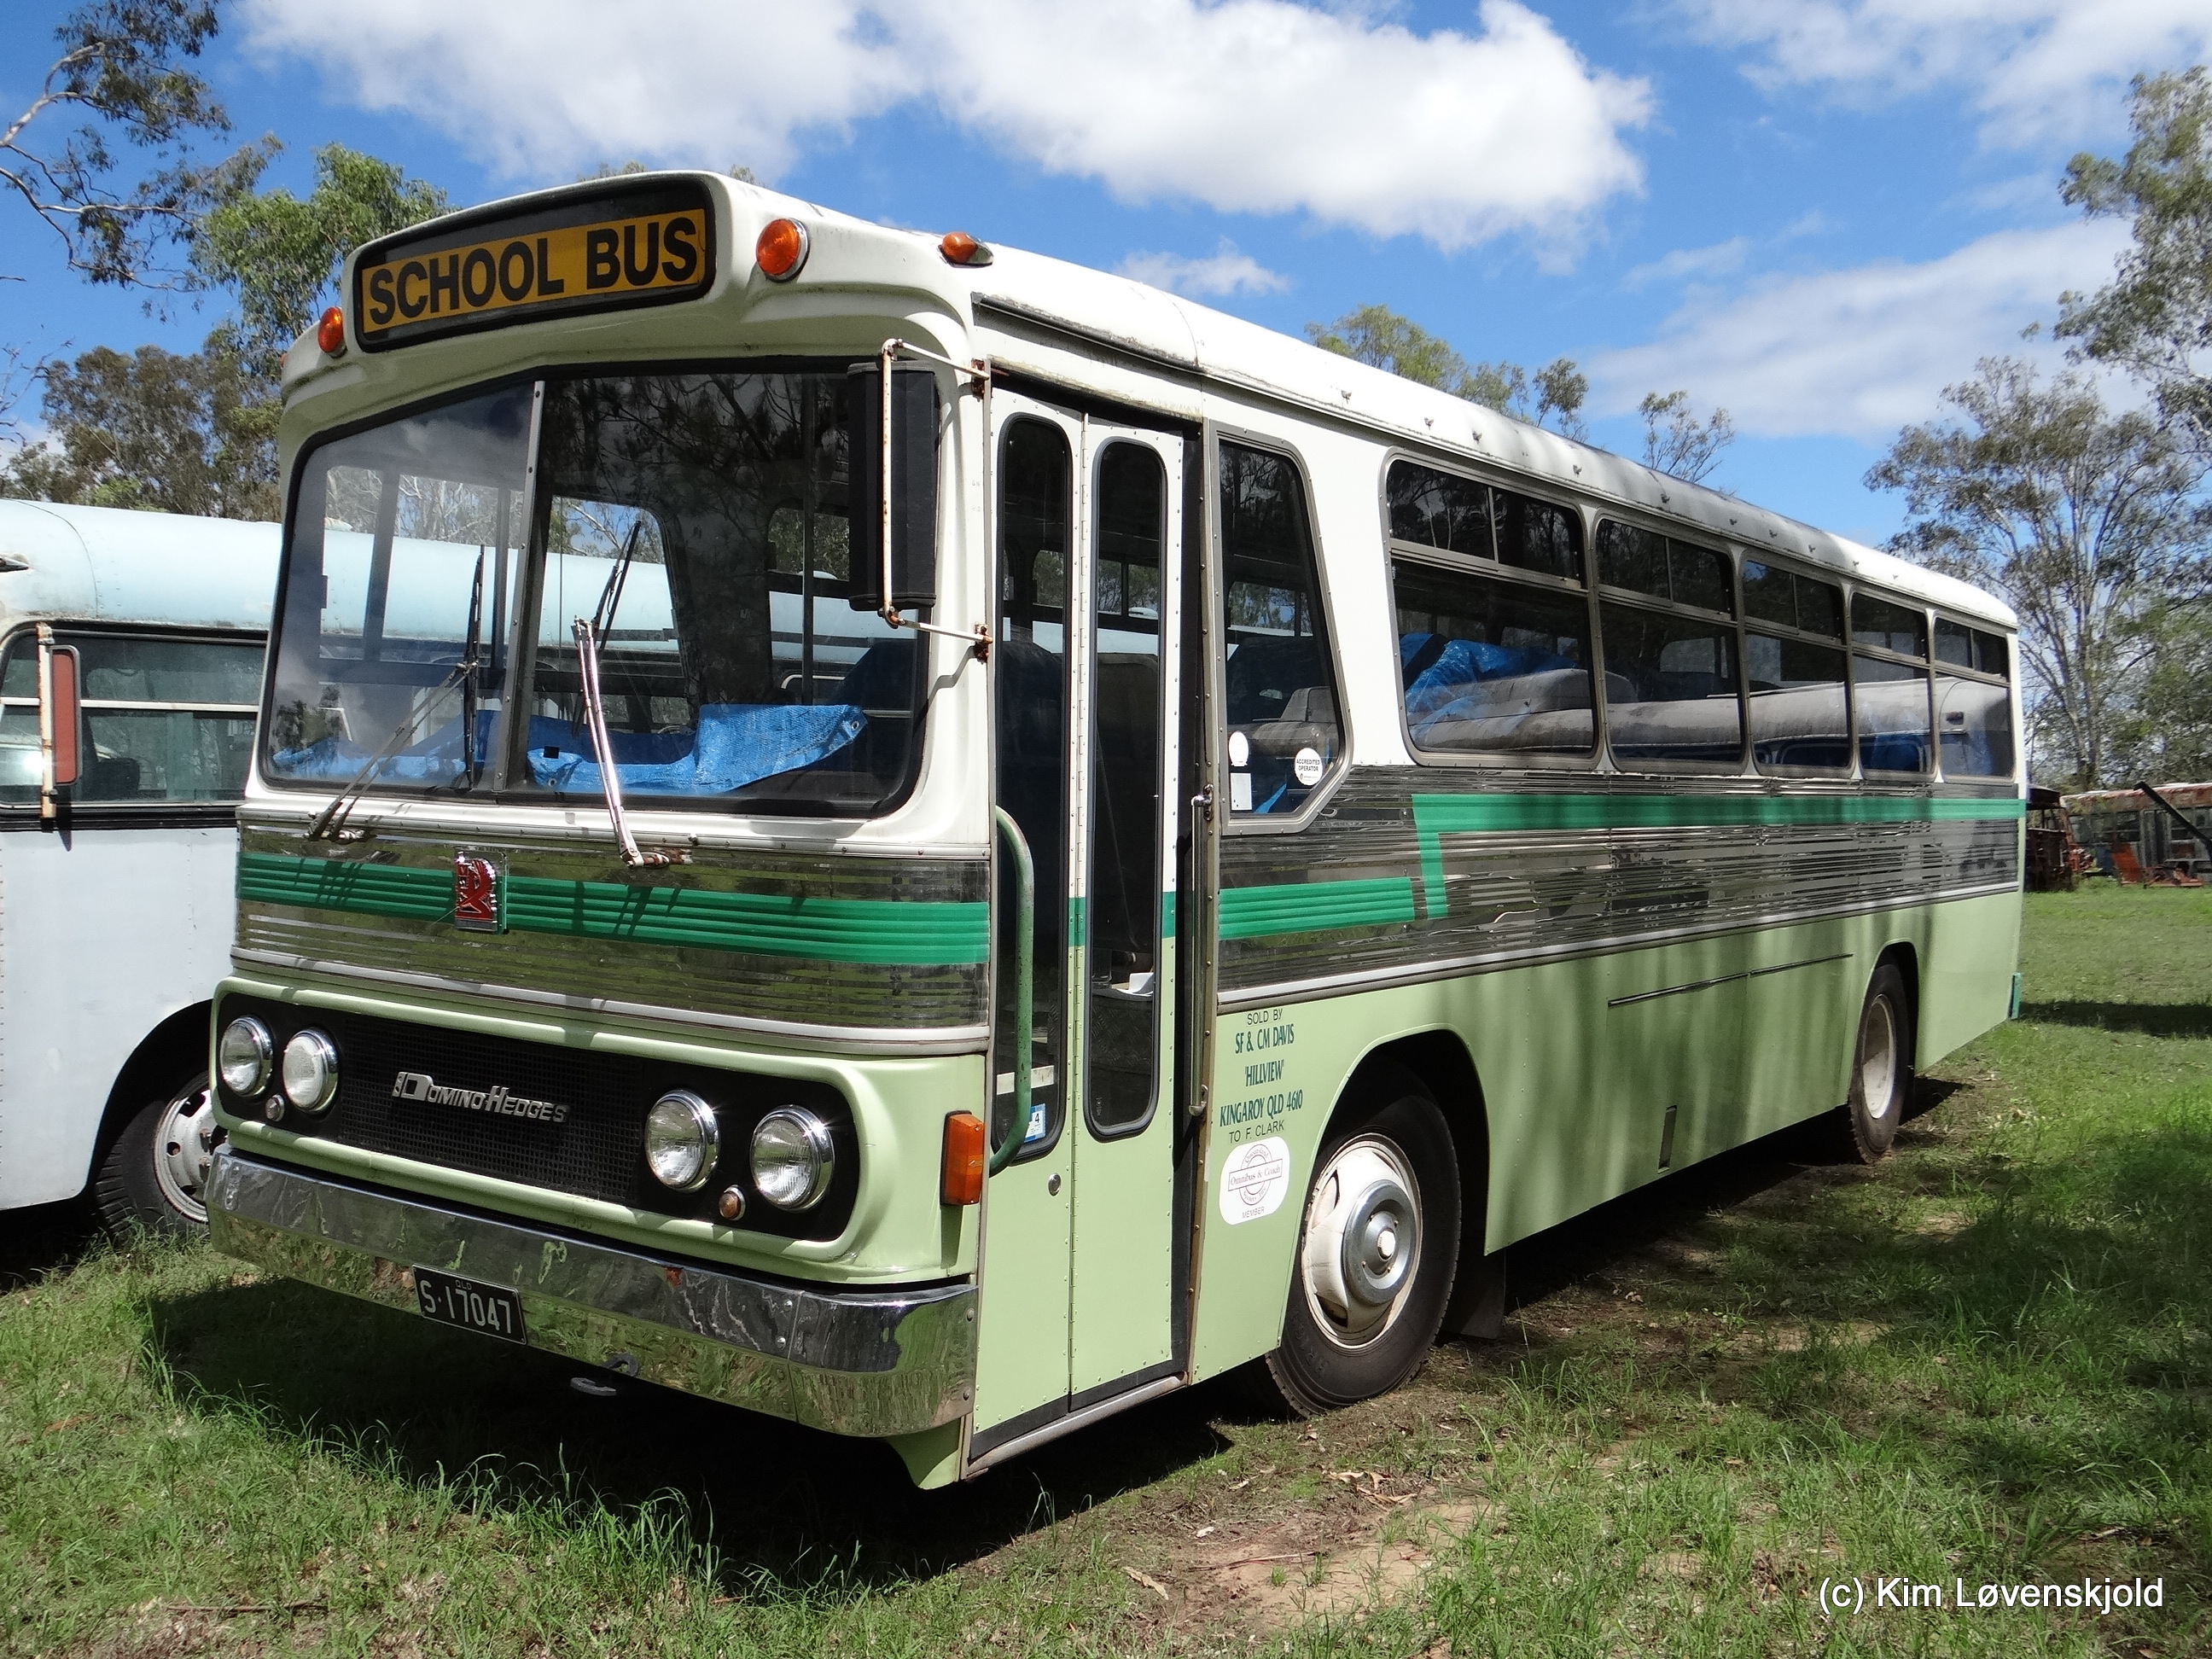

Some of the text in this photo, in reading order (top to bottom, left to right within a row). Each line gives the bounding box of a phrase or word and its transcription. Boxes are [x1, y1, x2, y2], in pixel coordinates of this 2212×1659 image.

[369, 217, 698, 325] SCHOOL BUS
[1247, 1008, 1283, 1026] SOLD BY
[1235, 1023, 1295, 1054] SF & CM DAVIS
[1034, 1113, 1039, 1123] 4
[1220, 1089, 1303, 1127] KINGAROY QLD 4610
[1229, 1120, 1284, 1144] TO F. CLARK
[1230, 1164, 1281, 1185] Omnibus & Coach
[1242, 1206, 1265, 1219] MEMBER
[455, 1280, 473, 1290] QLD
